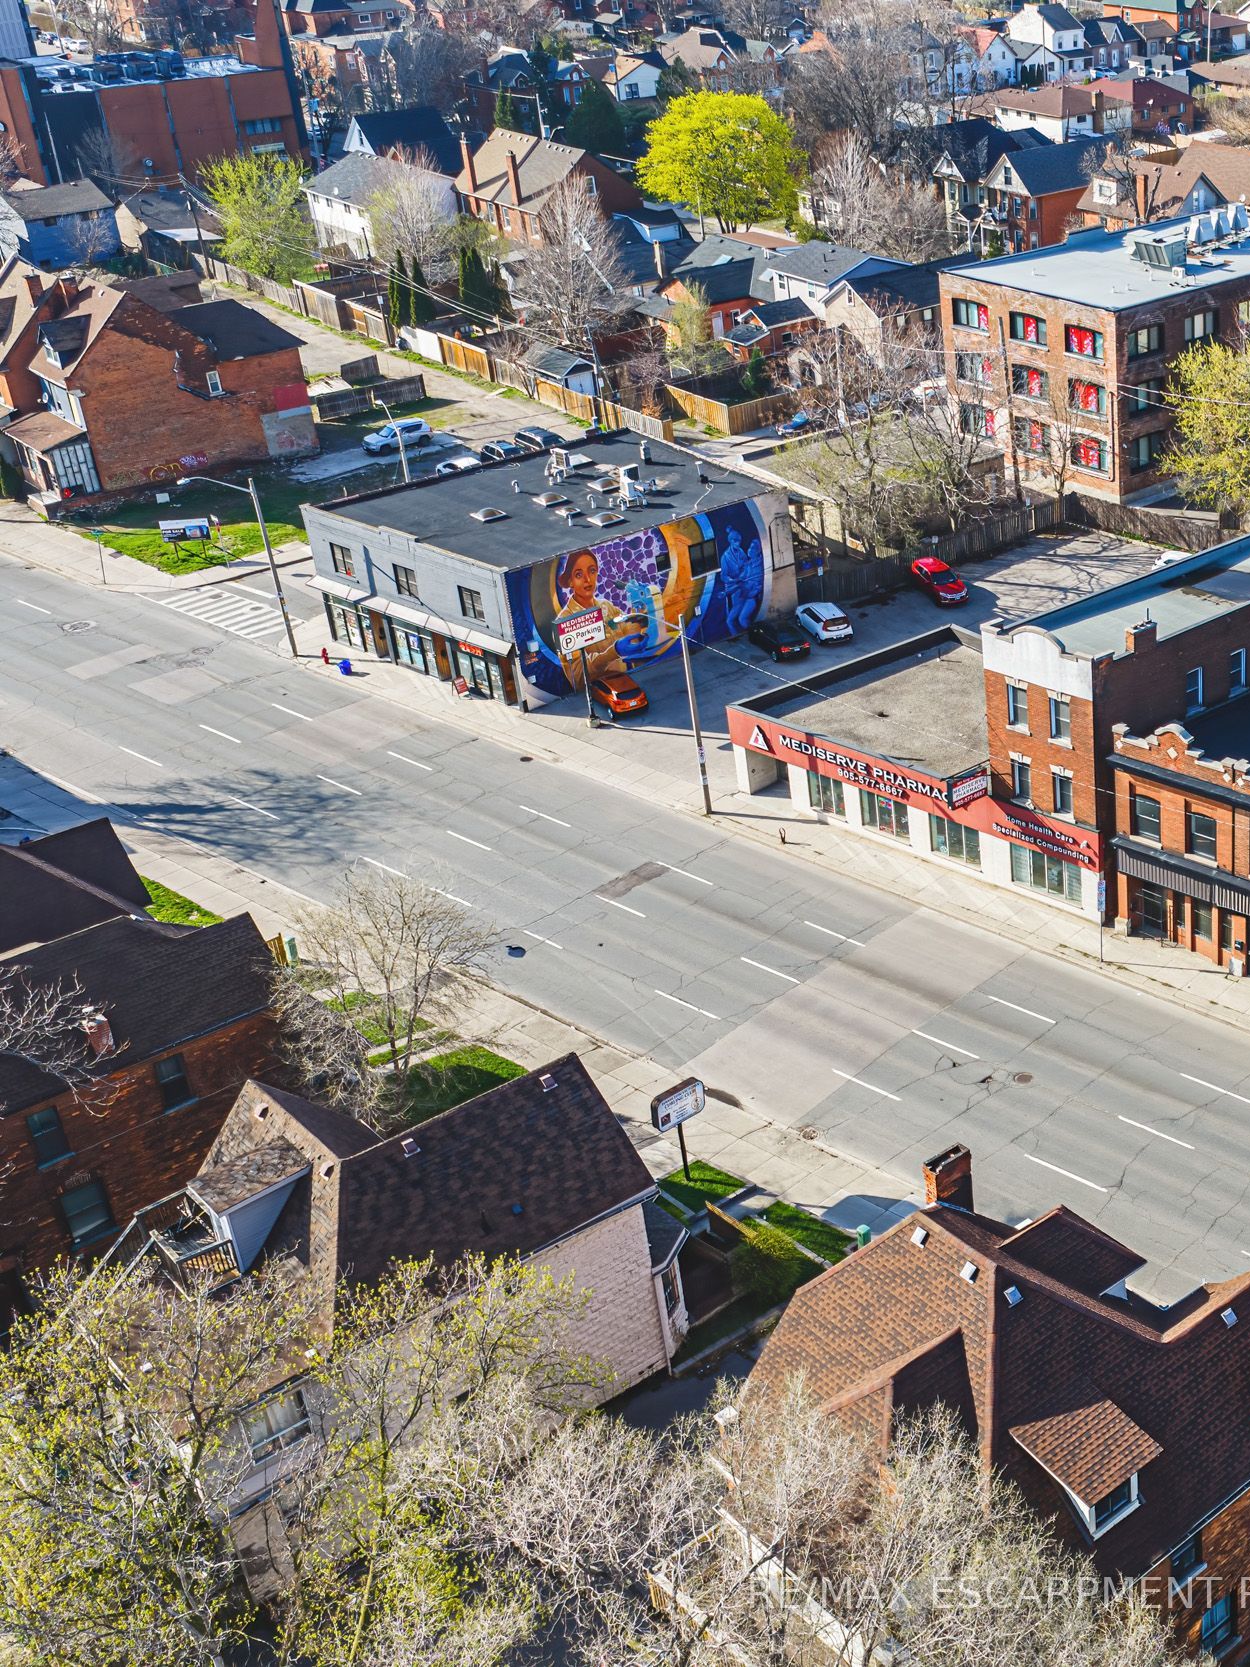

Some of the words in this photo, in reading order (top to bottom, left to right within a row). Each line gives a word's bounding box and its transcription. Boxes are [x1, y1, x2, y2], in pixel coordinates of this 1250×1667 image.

[560, 610, 599, 629] MEDISERVE
[564, 617, 597, 634] PHARMACY
[575, 626, 602, 640] Parking
[778, 734, 867, 775] MEDISERVE
[872, 767, 950, 803] PHARMAC
[837, 768, 904, 798] 905-577-6667
[953, 775, 987, 794] MEDISERVE
[955, 783, 985, 799] PHARMACY
[1005, 814, 1027, 828] Home
[1029, 821, 1053, 837] Health
[1055, 832, 1074, 844] Care
[992, 822, 1034, 844] Specialized
[1036, 839, 1090, 864] Compounding
